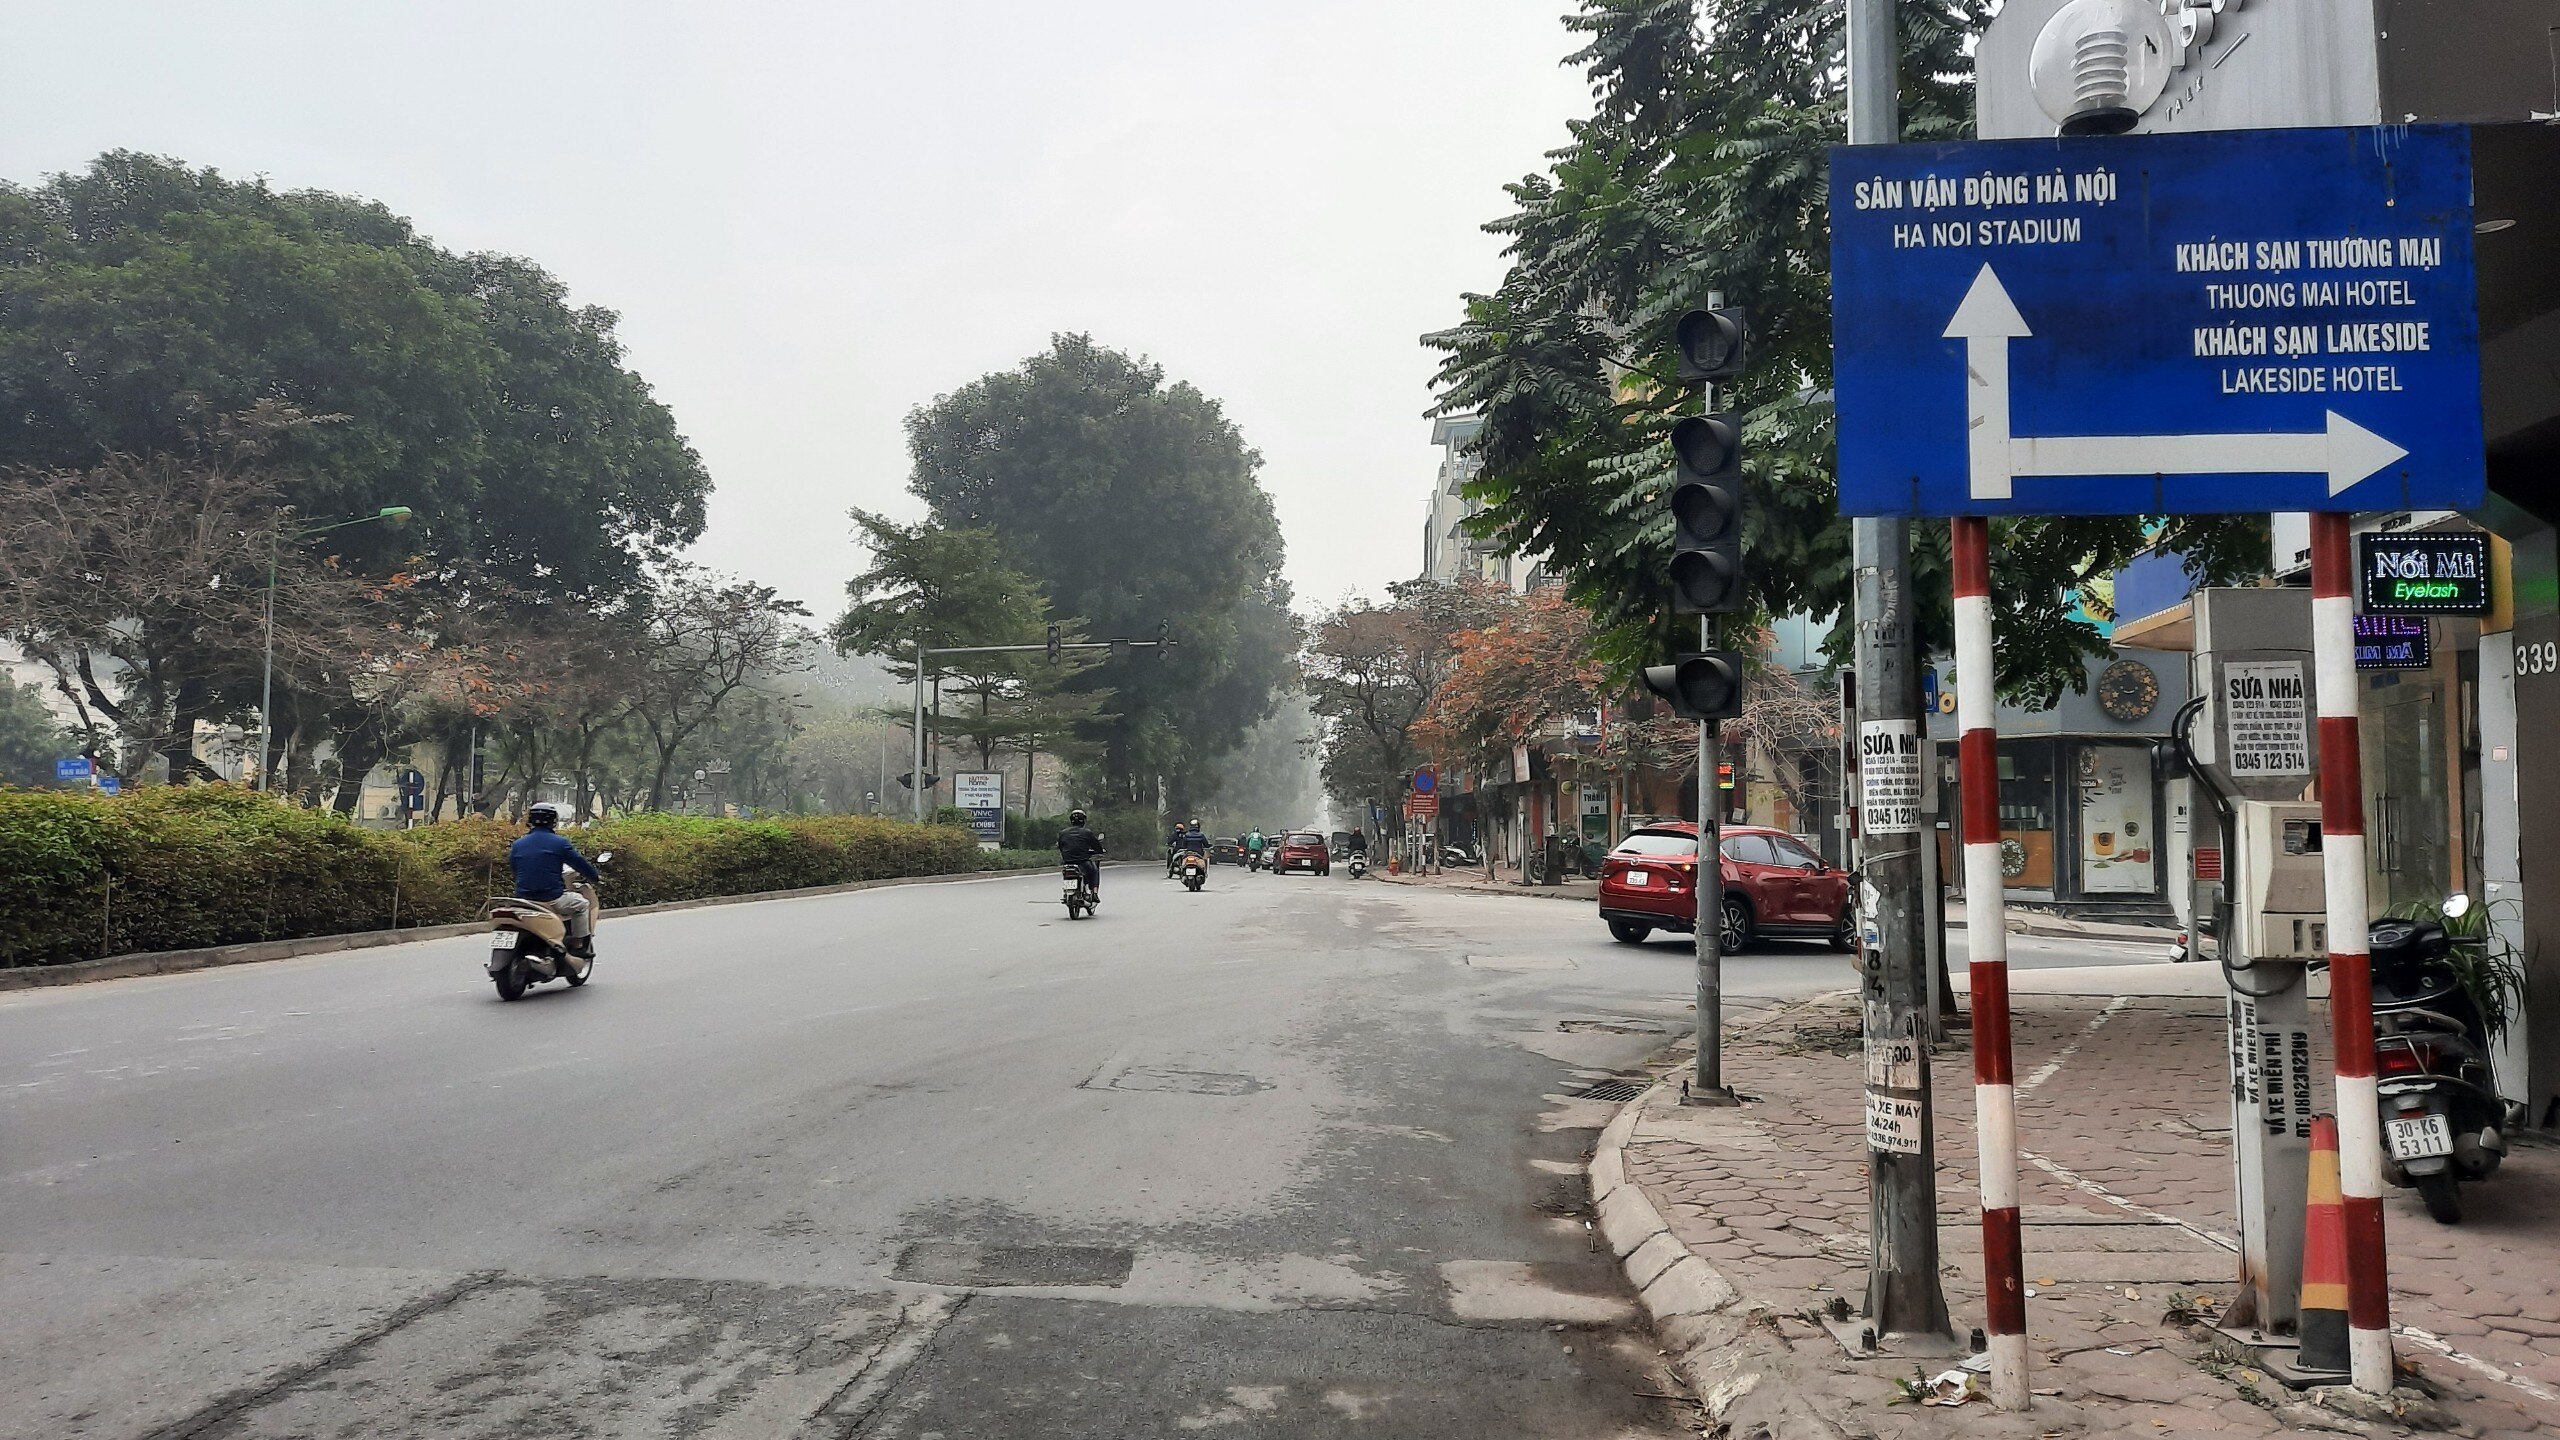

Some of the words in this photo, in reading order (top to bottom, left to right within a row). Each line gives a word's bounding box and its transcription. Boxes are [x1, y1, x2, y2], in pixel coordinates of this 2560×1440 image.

[1855, 175, 1903, 211] SÂN
[1909, 173, 1957, 212] VẬN
[1963, 170, 2029, 210] ĐỘNG
[2036, 167, 2069, 204] HÀ
[2075, 166, 2117, 206] NỘI
[1894, 223, 1926, 249] HA
[1932, 221, 1972, 247] NOI
[1978, 217, 2081, 246] STADIUM
[2176, 235, 2249, 273] KHÁCH
[2255, 240, 2300, 275] SẠN
[2306, 236, 2393, 269] THƯƠNG
[2399, 237, 2441, 272] MẠI
[2205, 282, 2296, 310] THUONG
[2302, 281, 2340, 307] MAI
[2345, 280, 2416, 306] HOTEL
[2194, 319, 2267, 357] KHÁCH
[2273, 325, 2318, 360] SẠN
[2326, 322, 2430, 353] LAKESIDE
[2222, 367, 2326, 394] LAKESIDE
[2332, 366, 2403, 392] HOTEL
[2375, 549, 2431, 578] Nối
[2435, 552, 2477, 578] Mi
[2395, 582, 2459, 600] Eyelash
[2516, 641, 2558, 676] 339
[2230, 670, 2264, 699] SỬA
[2269, 674, 2304, 699] NHÀ
[1863, 726, 1895, 756] SỬA
[2235, 752, 2261, 770] 0345
[2263, 752, 2283, 770] 123
[2284, 752, 2305, 769] 514
[1868, 808, 1892, 825] 0345
[1894, 807, 1911, 824] 123
[2258, 1031, 2282, 1056] PHÍ
[2248, 1067, 2259, 1085] XE
[2259, 1058, 2284, 1095] MIỄN
[1878, 1100, 1893, 1115] XE
[1895, 1102, 1921, 1119] MÁY
[2267, 1097, 2286, 1115] XE
[2263, 1117, 2287, 1136] VÁ
[2395, 1118, 2440, 1139] 30-K6
[2399, 1135, 2444, 1157] 5311
